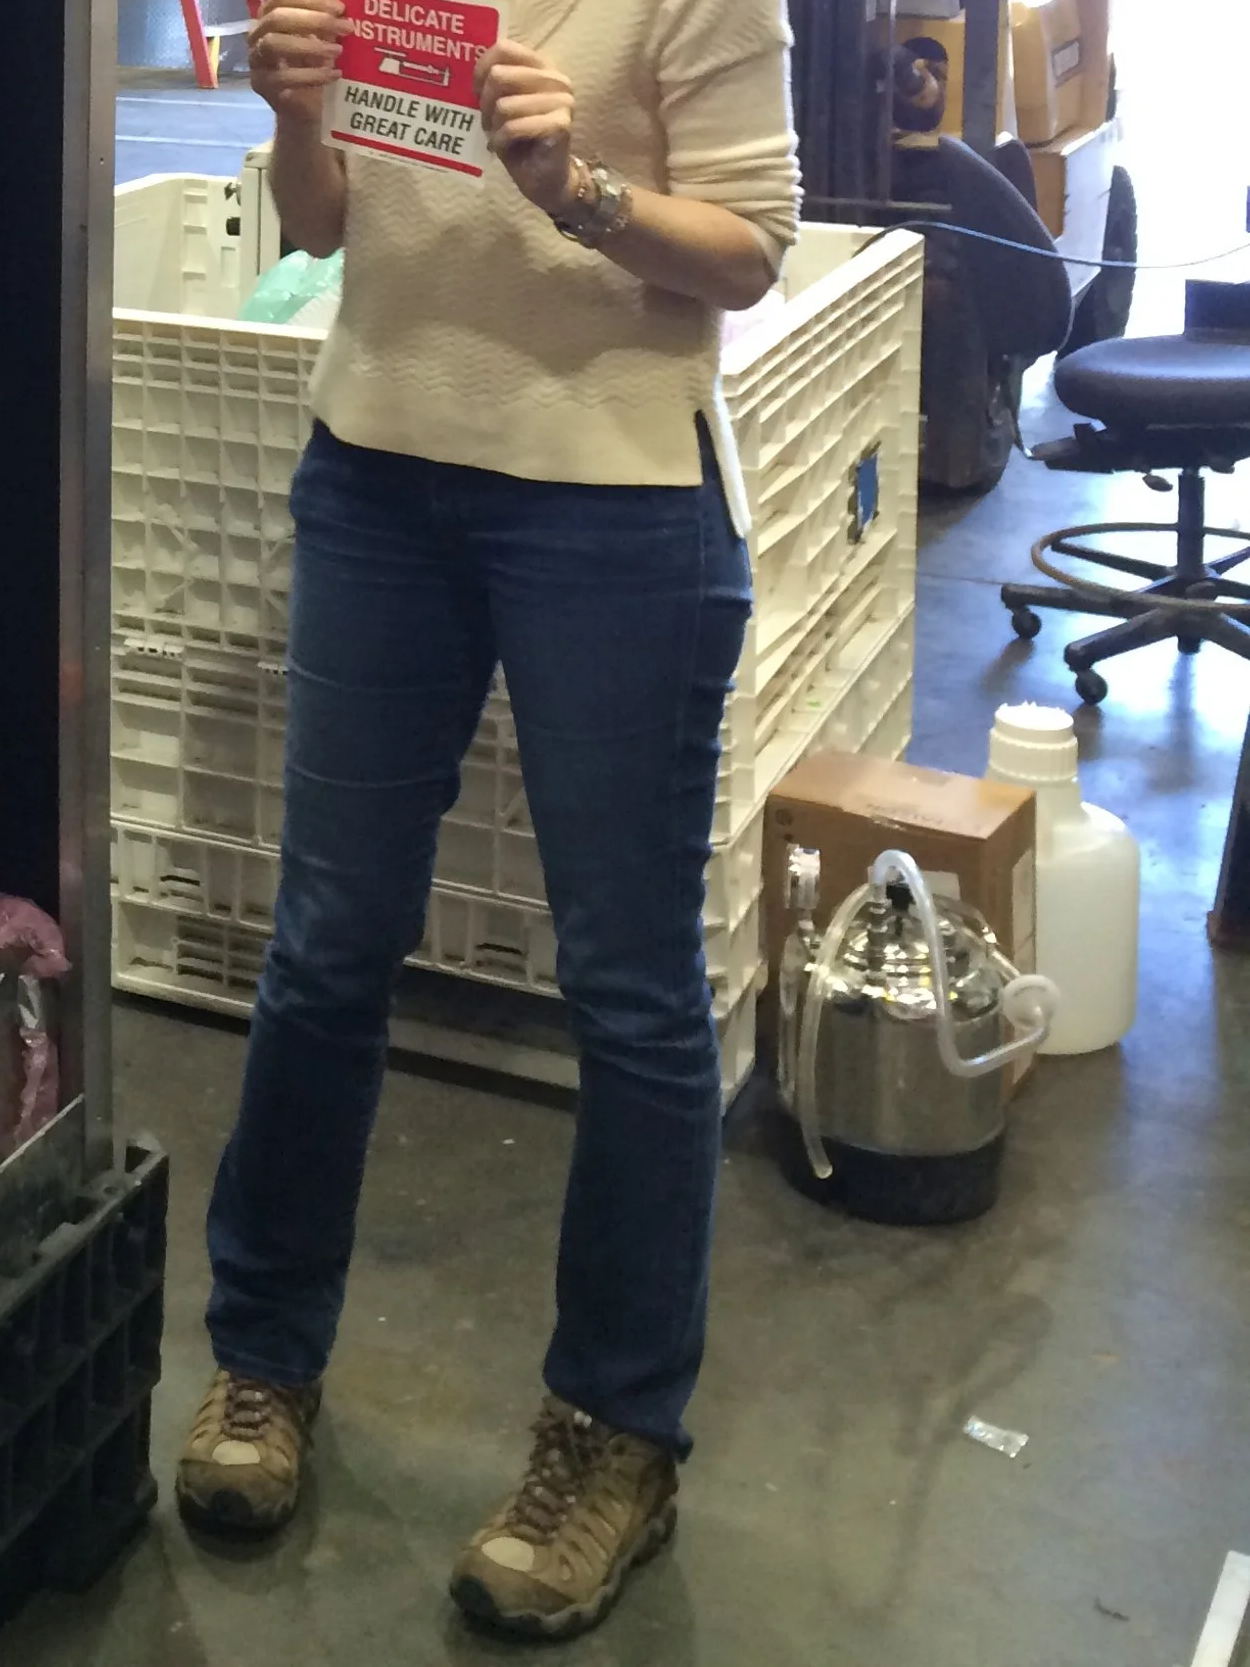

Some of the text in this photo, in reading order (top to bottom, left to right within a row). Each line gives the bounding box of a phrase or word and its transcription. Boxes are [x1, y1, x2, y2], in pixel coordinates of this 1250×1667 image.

[346, 16, 489, 63] NSTRUMENTS
[344, 85, 474, 132] HANDLE WITH
[350, 111, 465, 155] GREAT CARE
